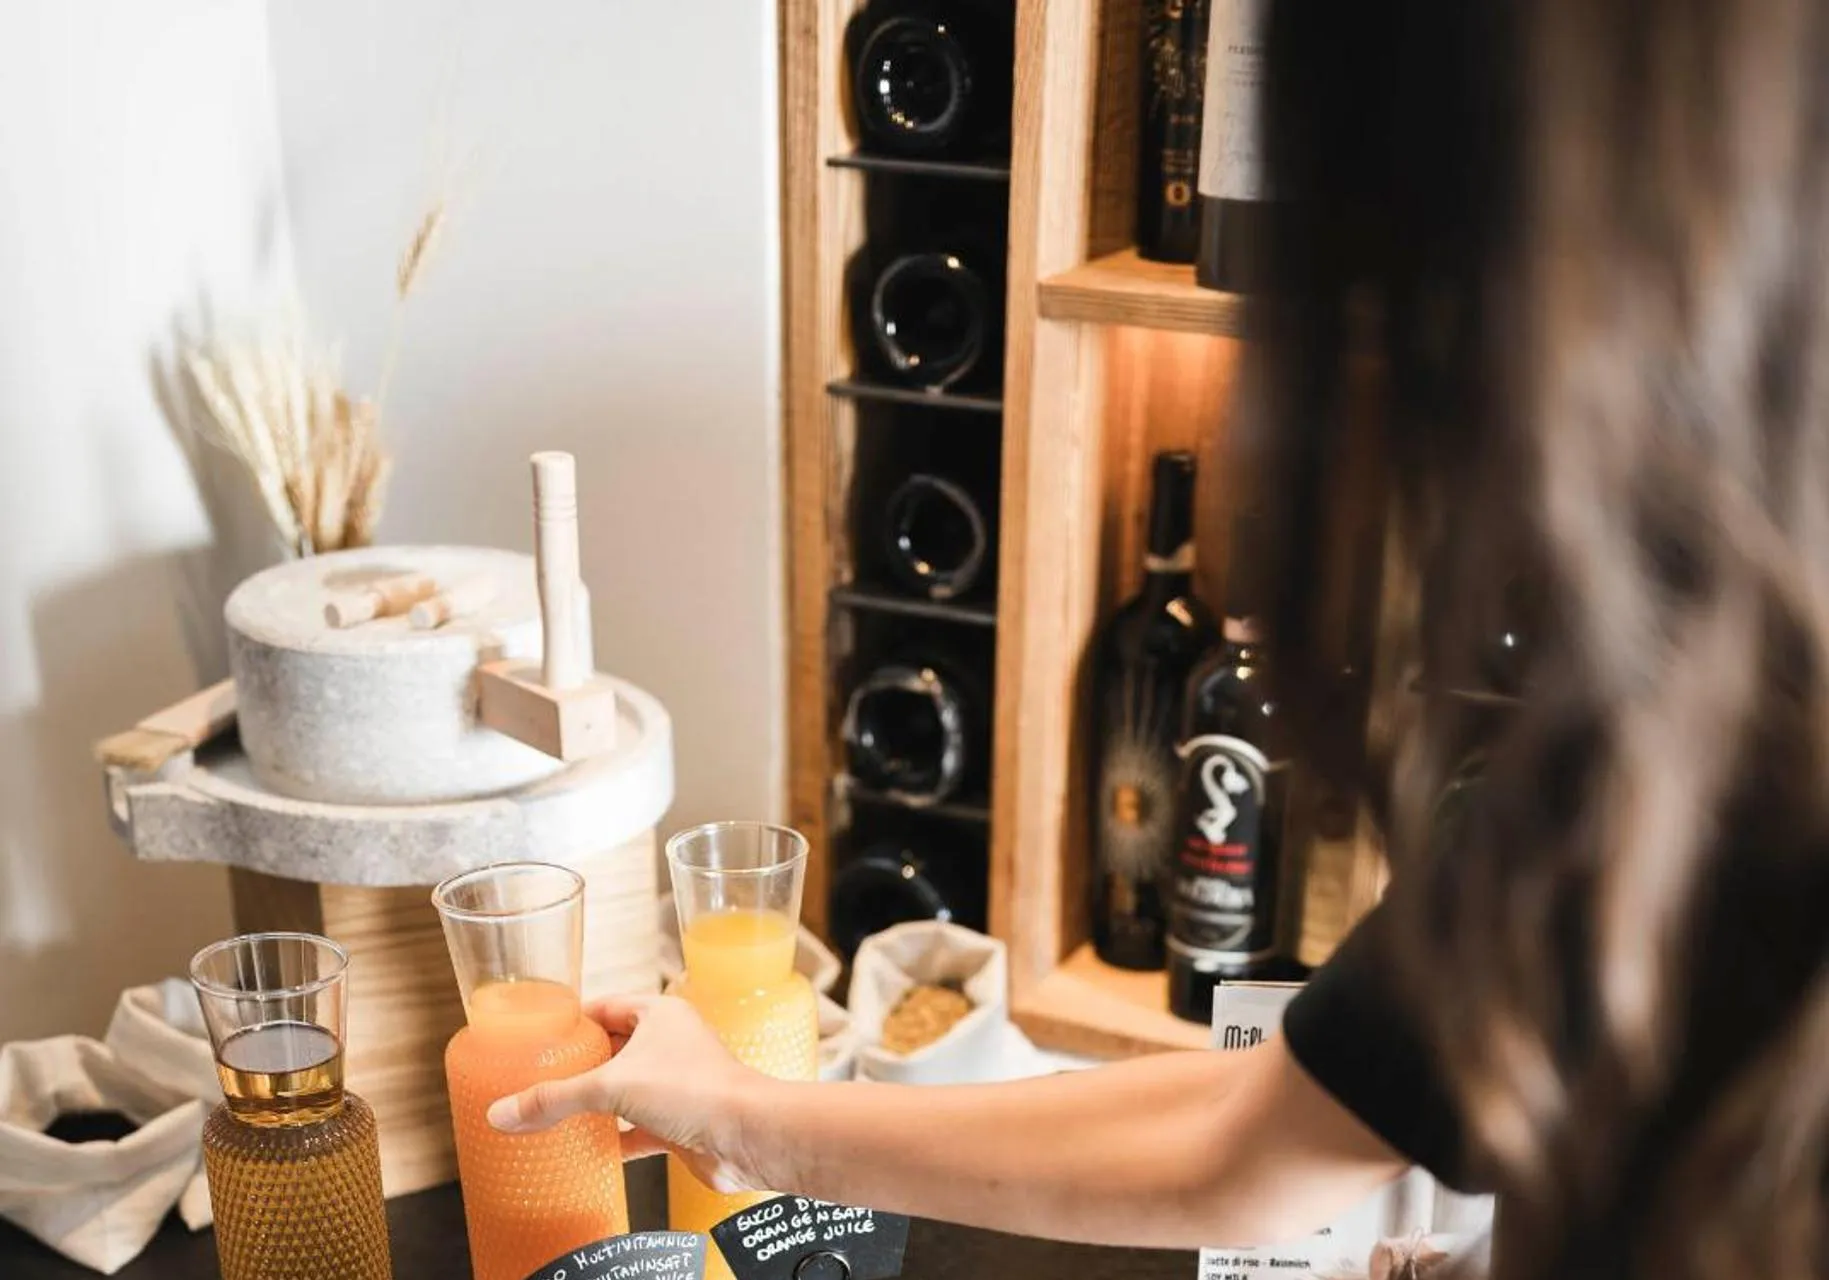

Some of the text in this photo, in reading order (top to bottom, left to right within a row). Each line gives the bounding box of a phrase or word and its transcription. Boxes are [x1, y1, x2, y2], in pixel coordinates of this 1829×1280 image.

[737, 1204, 784, 1231] SUCCO
[573, 1234, 698, 1270] MULTIVITAMINICO
[757, 1220, 876, 1261] ORANGE JUICE
